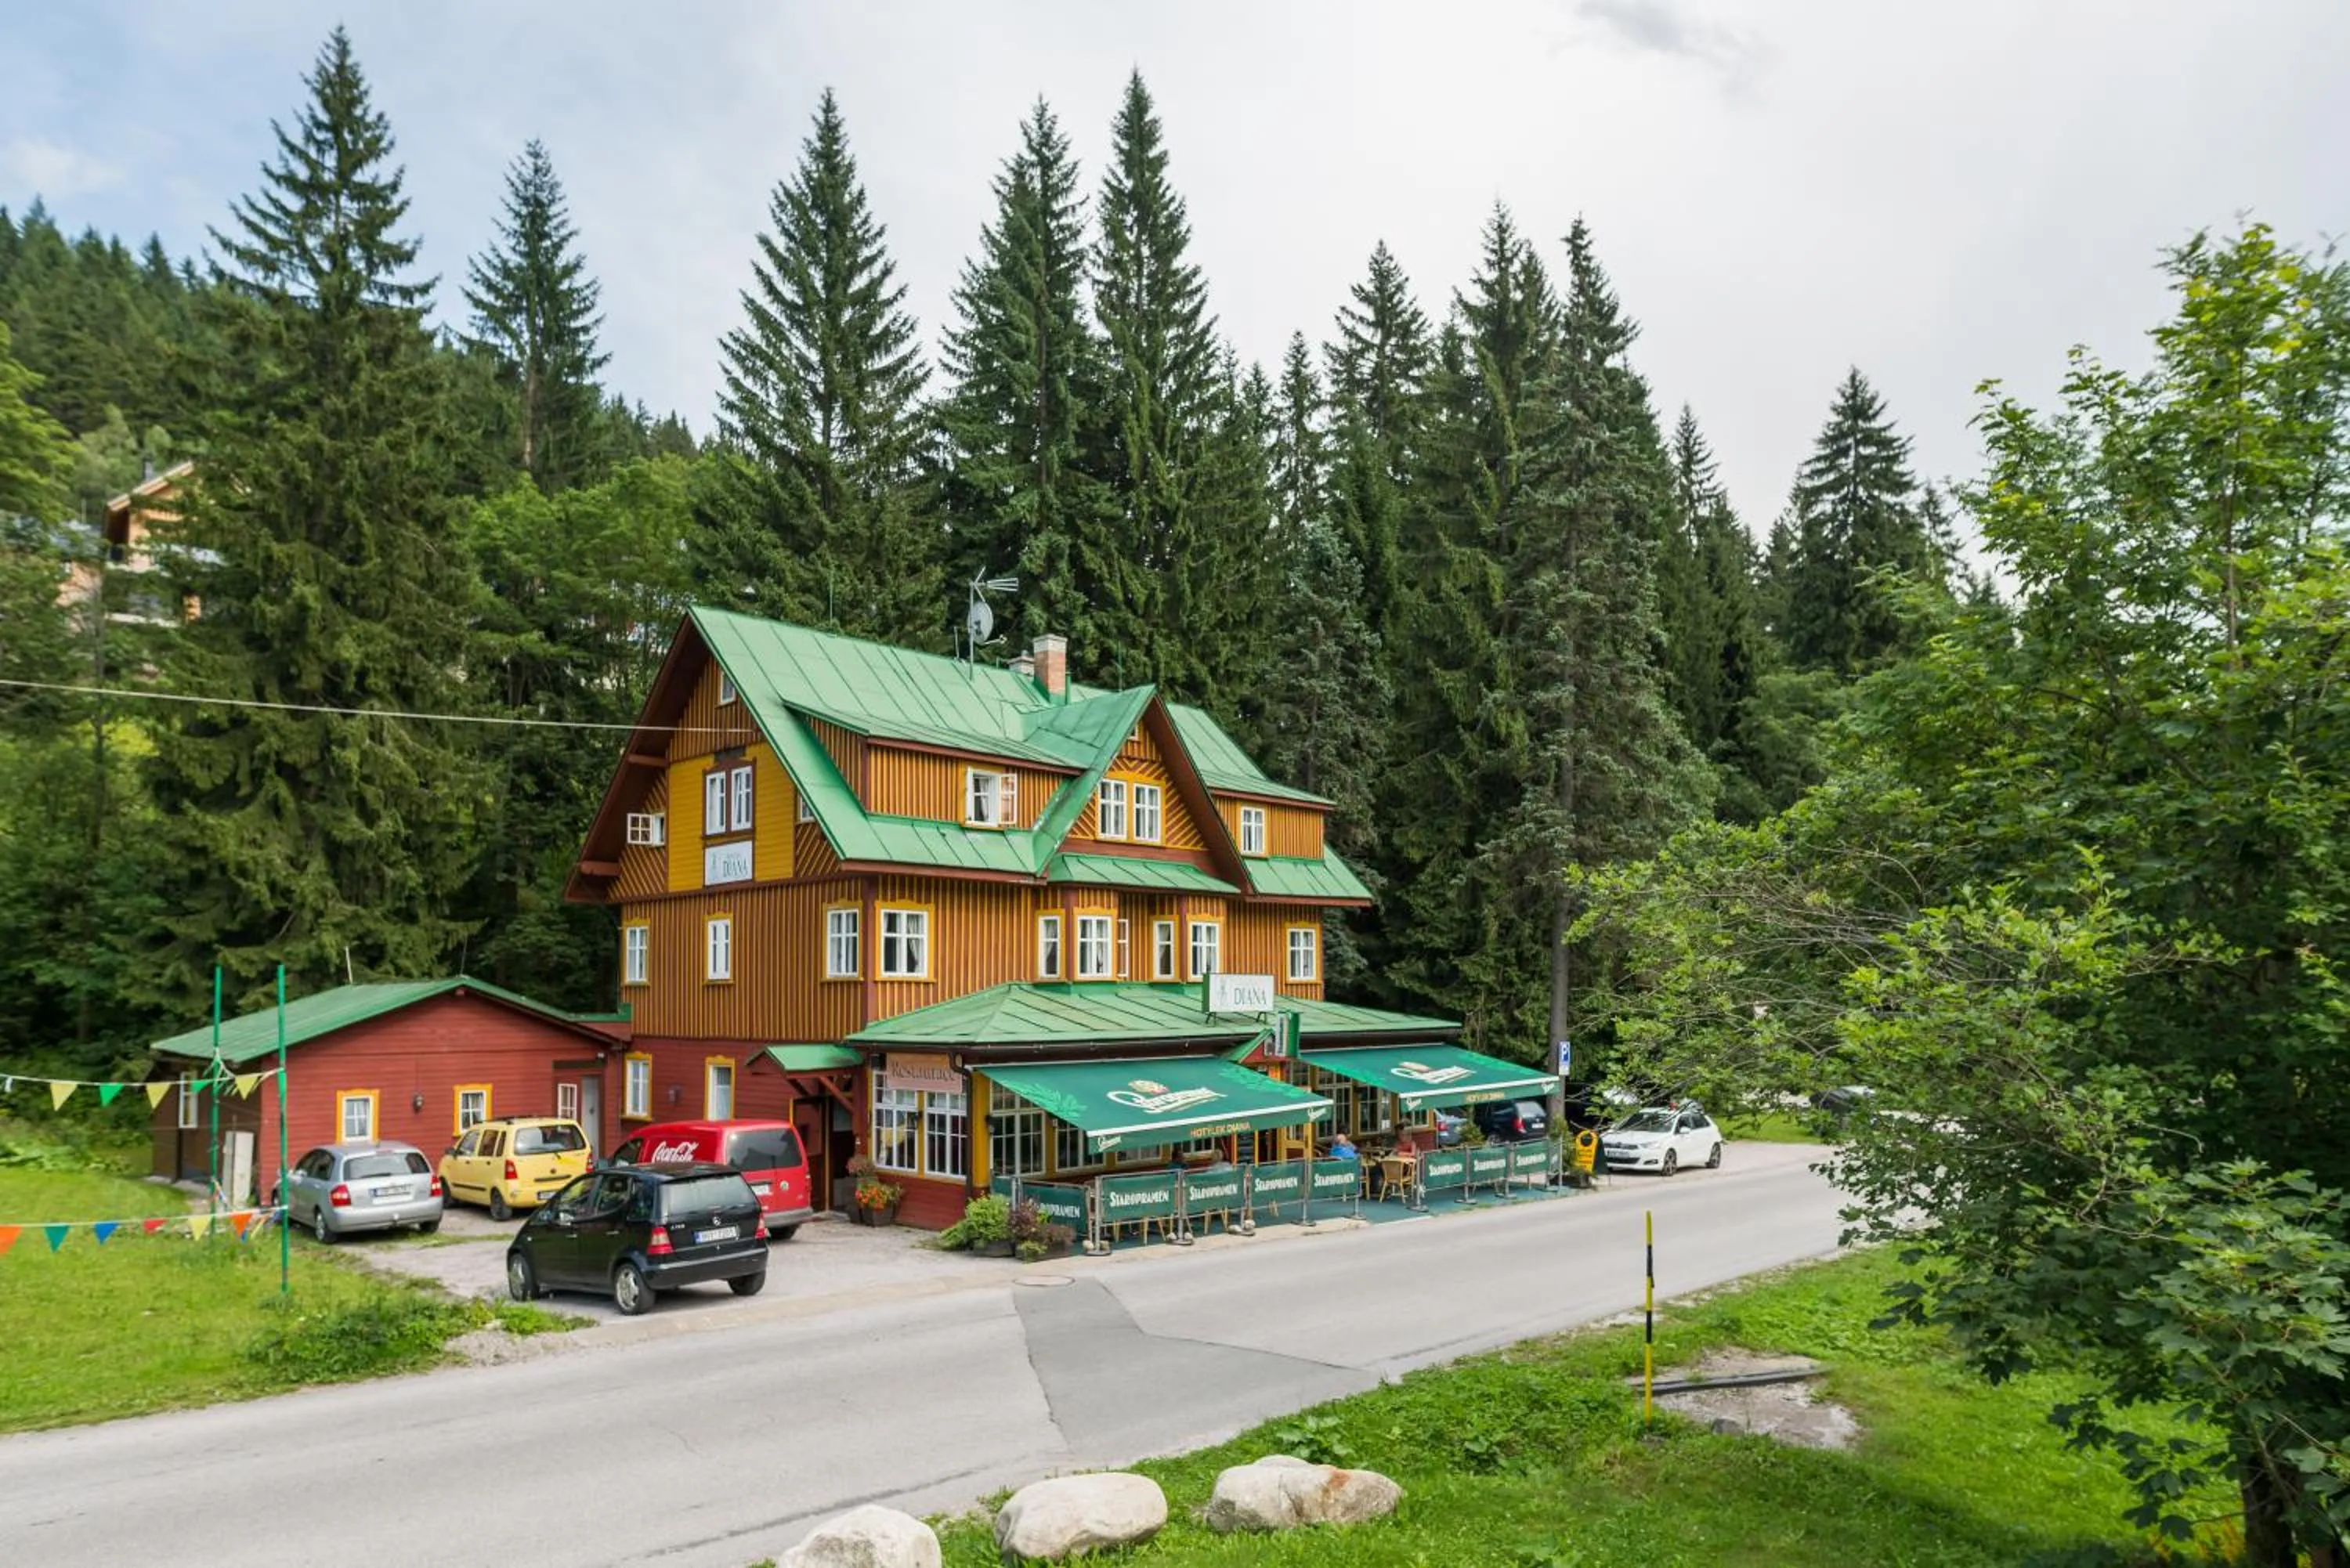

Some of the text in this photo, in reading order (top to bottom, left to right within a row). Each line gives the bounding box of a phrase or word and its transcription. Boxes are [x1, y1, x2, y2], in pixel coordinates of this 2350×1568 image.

[723, 858, 748, 877] DIANA
[1234, 987, 1267, 1006] DIANA
[1109, 1190, 1170, 1207] STAROPRAMEN
